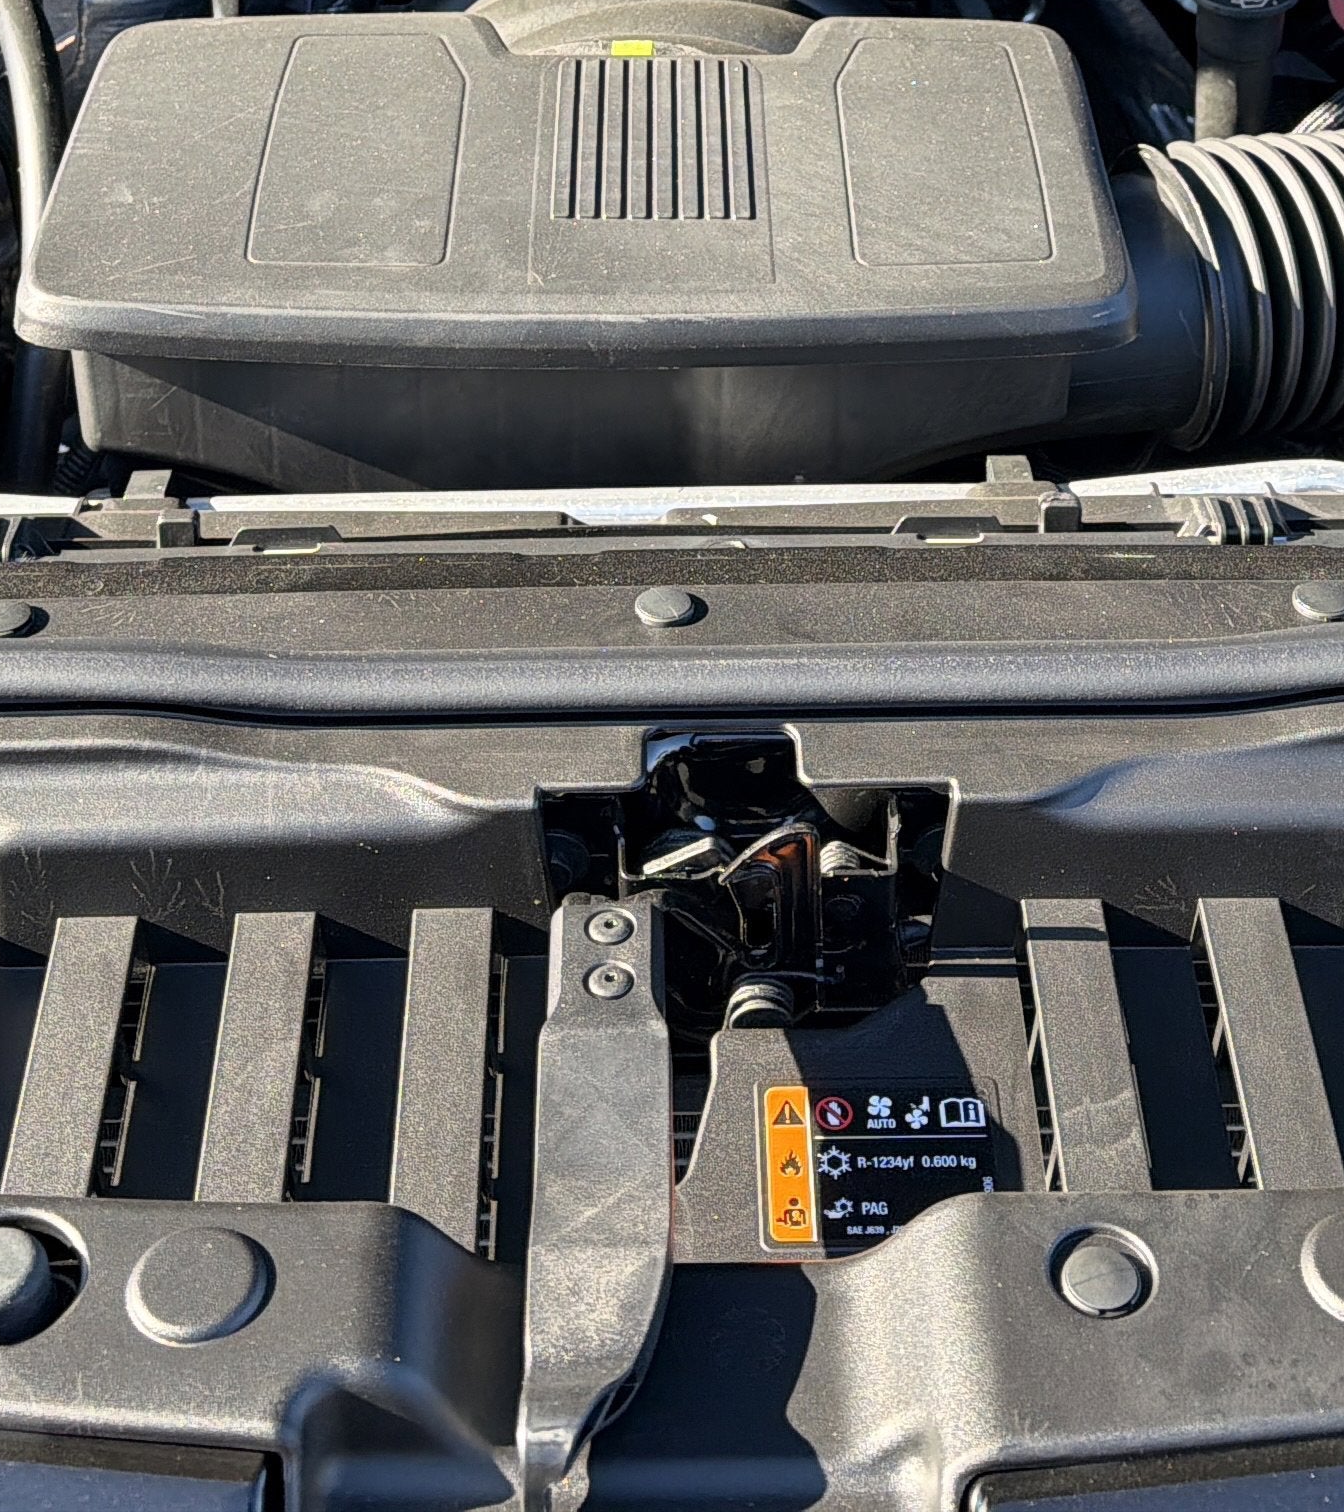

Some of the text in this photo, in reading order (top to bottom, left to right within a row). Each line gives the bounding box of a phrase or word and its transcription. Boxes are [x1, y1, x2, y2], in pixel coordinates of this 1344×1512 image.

[866, 1118, 897, 1130] AUTO
[857, 1154, 977, 1171] R-1234yf 0.600 kg
[861, 1201, 889, 1216] PAG
[846, 1225, 864, 1235] SAE
